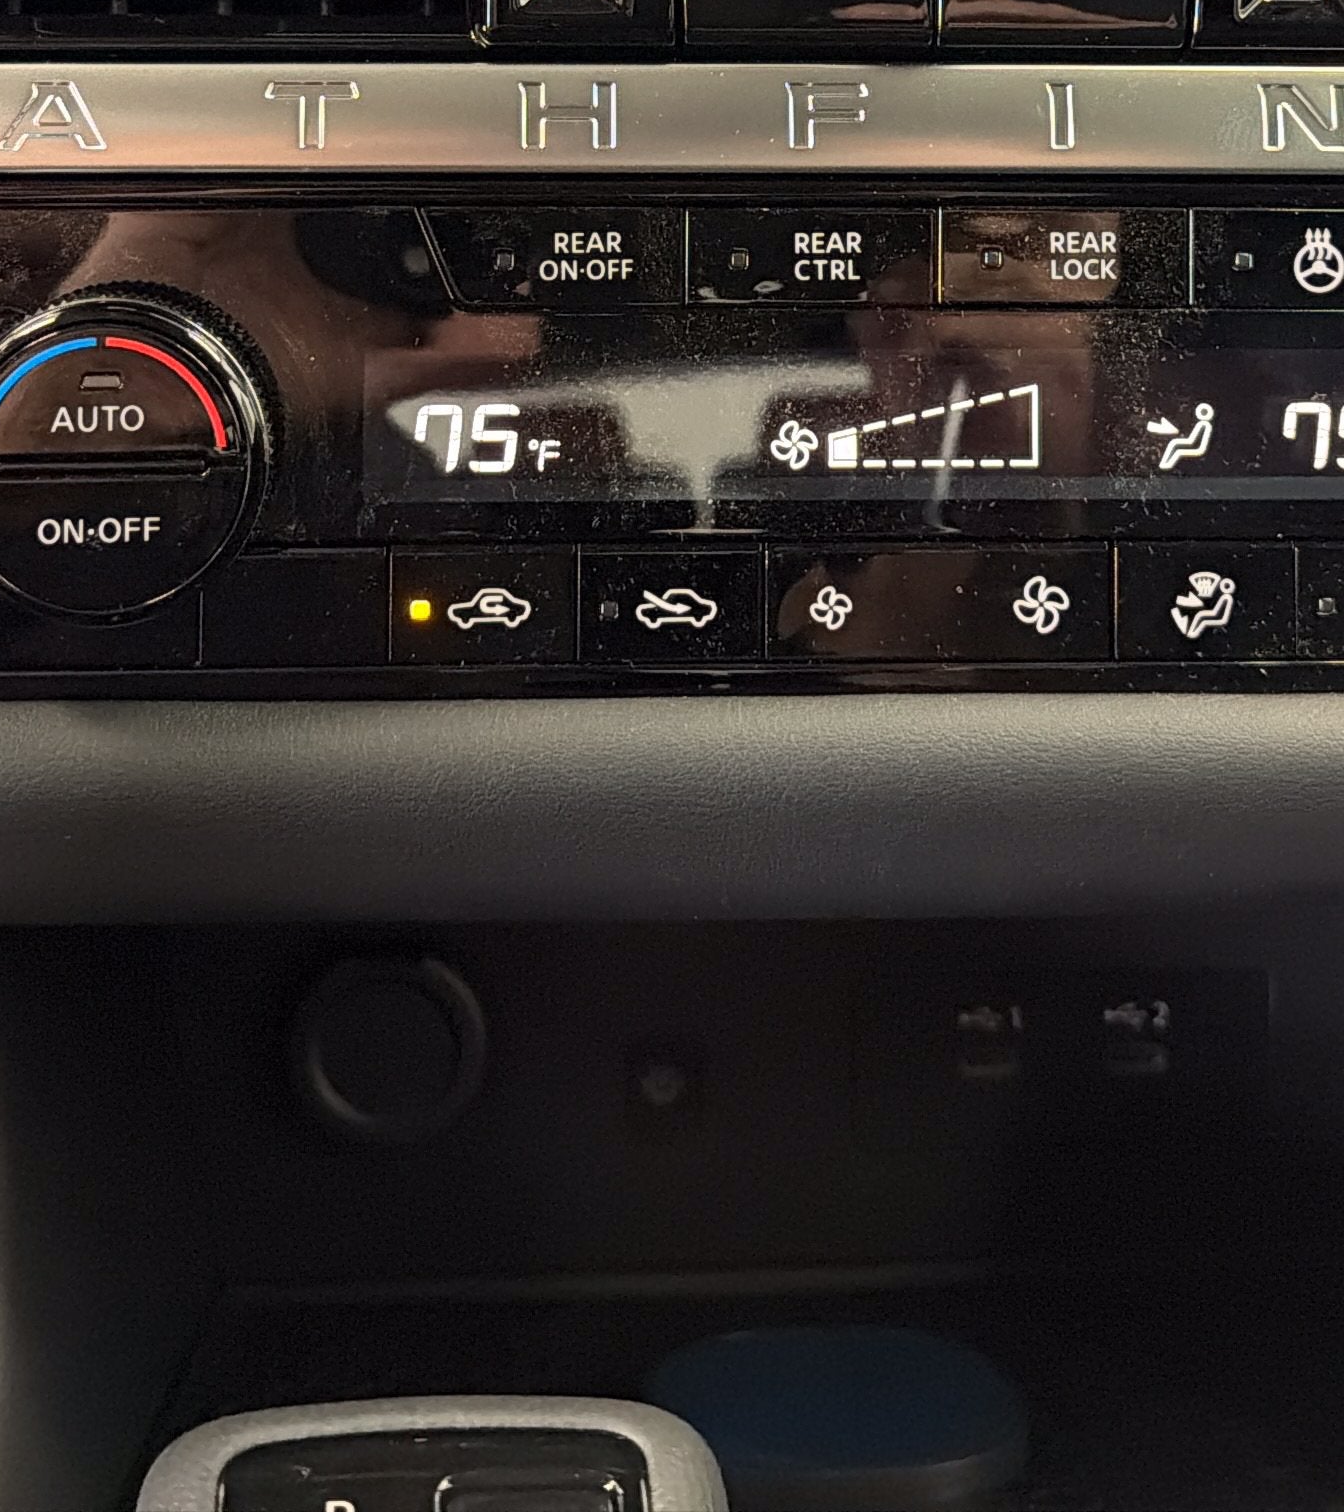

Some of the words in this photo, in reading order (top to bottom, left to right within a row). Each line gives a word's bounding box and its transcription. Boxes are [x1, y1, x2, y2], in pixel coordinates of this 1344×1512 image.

[554, 231, 622, 254] REAR
[794, 231, 862, 254] REAR
[1049, 231, 1117, 254] REAR
[794, 259, 861, 281] CTRL
[1050, 258, 1117, 280] LOCK
[50, 404, 145, 433] AUTO
[413, 403, 521, 473] 75
